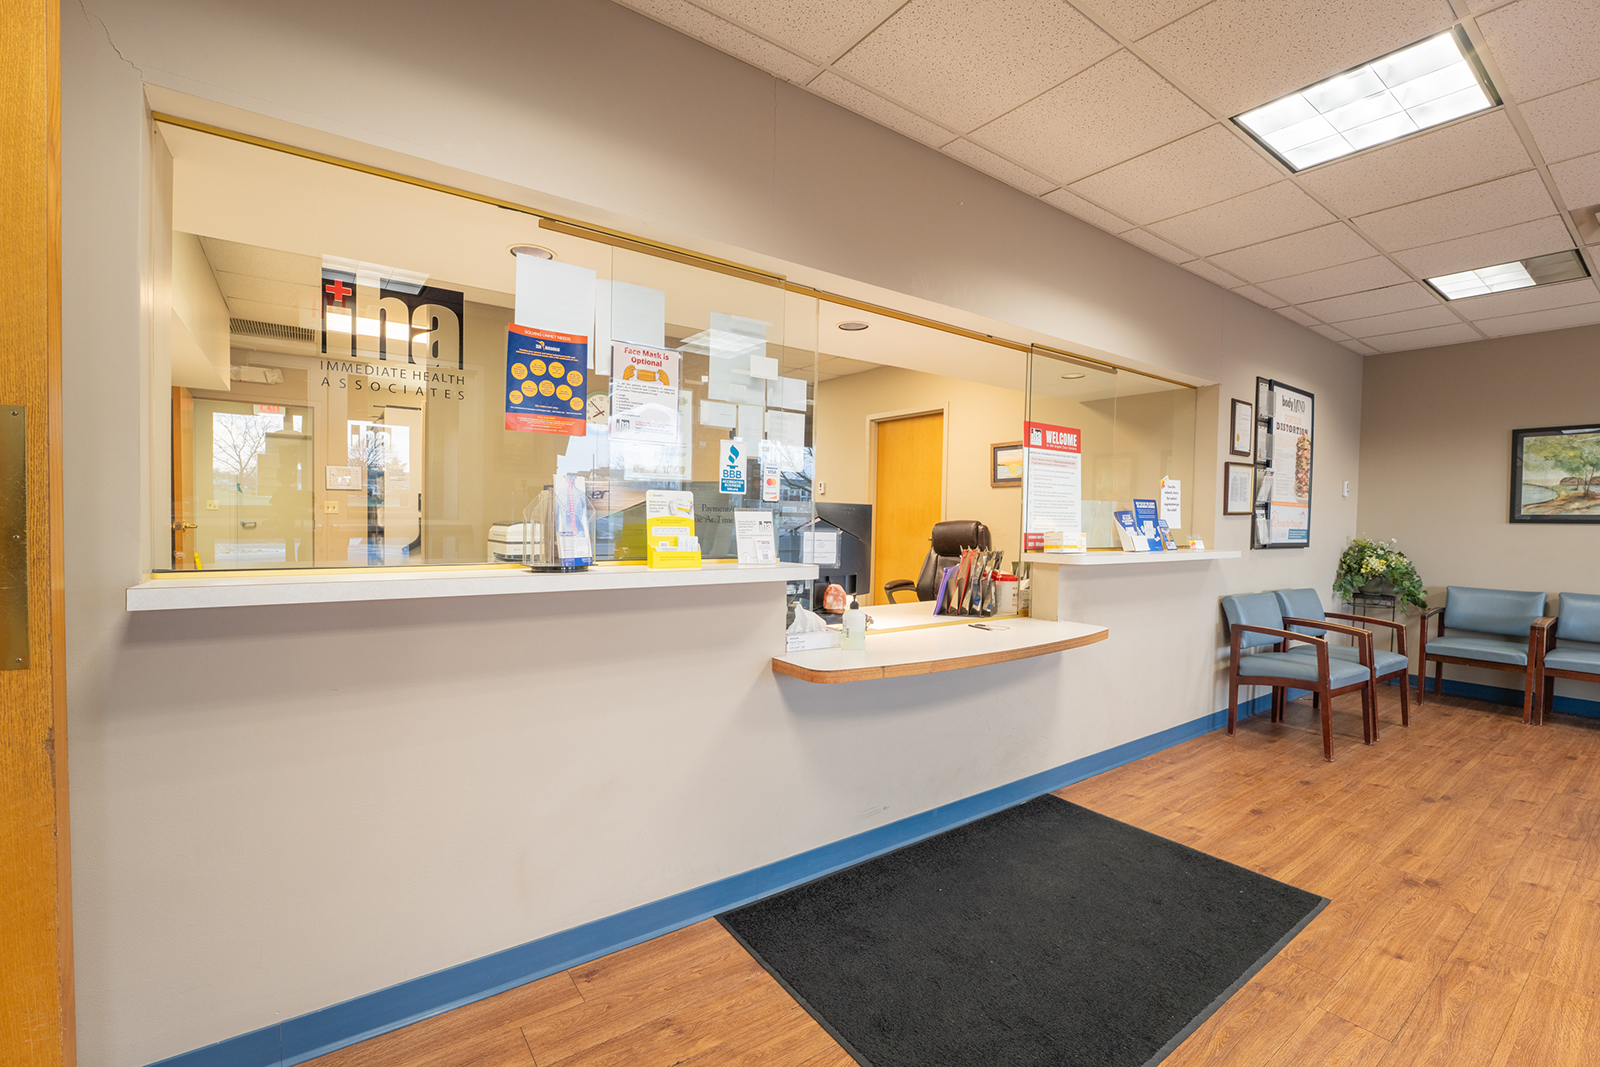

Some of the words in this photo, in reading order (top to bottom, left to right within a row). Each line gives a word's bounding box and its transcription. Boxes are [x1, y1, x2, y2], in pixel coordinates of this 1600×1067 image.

[624, 346, 641, 355] Face
[642, 350, 662, 359] Mask
[631, 356, 663, 367] Optional
[320, 360, 407, 379] IMMEDIATE
[412, 371, 465, 385] HEALTH
[320, 377, 465, 401] ASSOCIATES
[1276, 421, 1309, 435] DISTORTION
[1045, 430, 1078, 447] WELCOME
[722, 469, 742, 479] BBB
